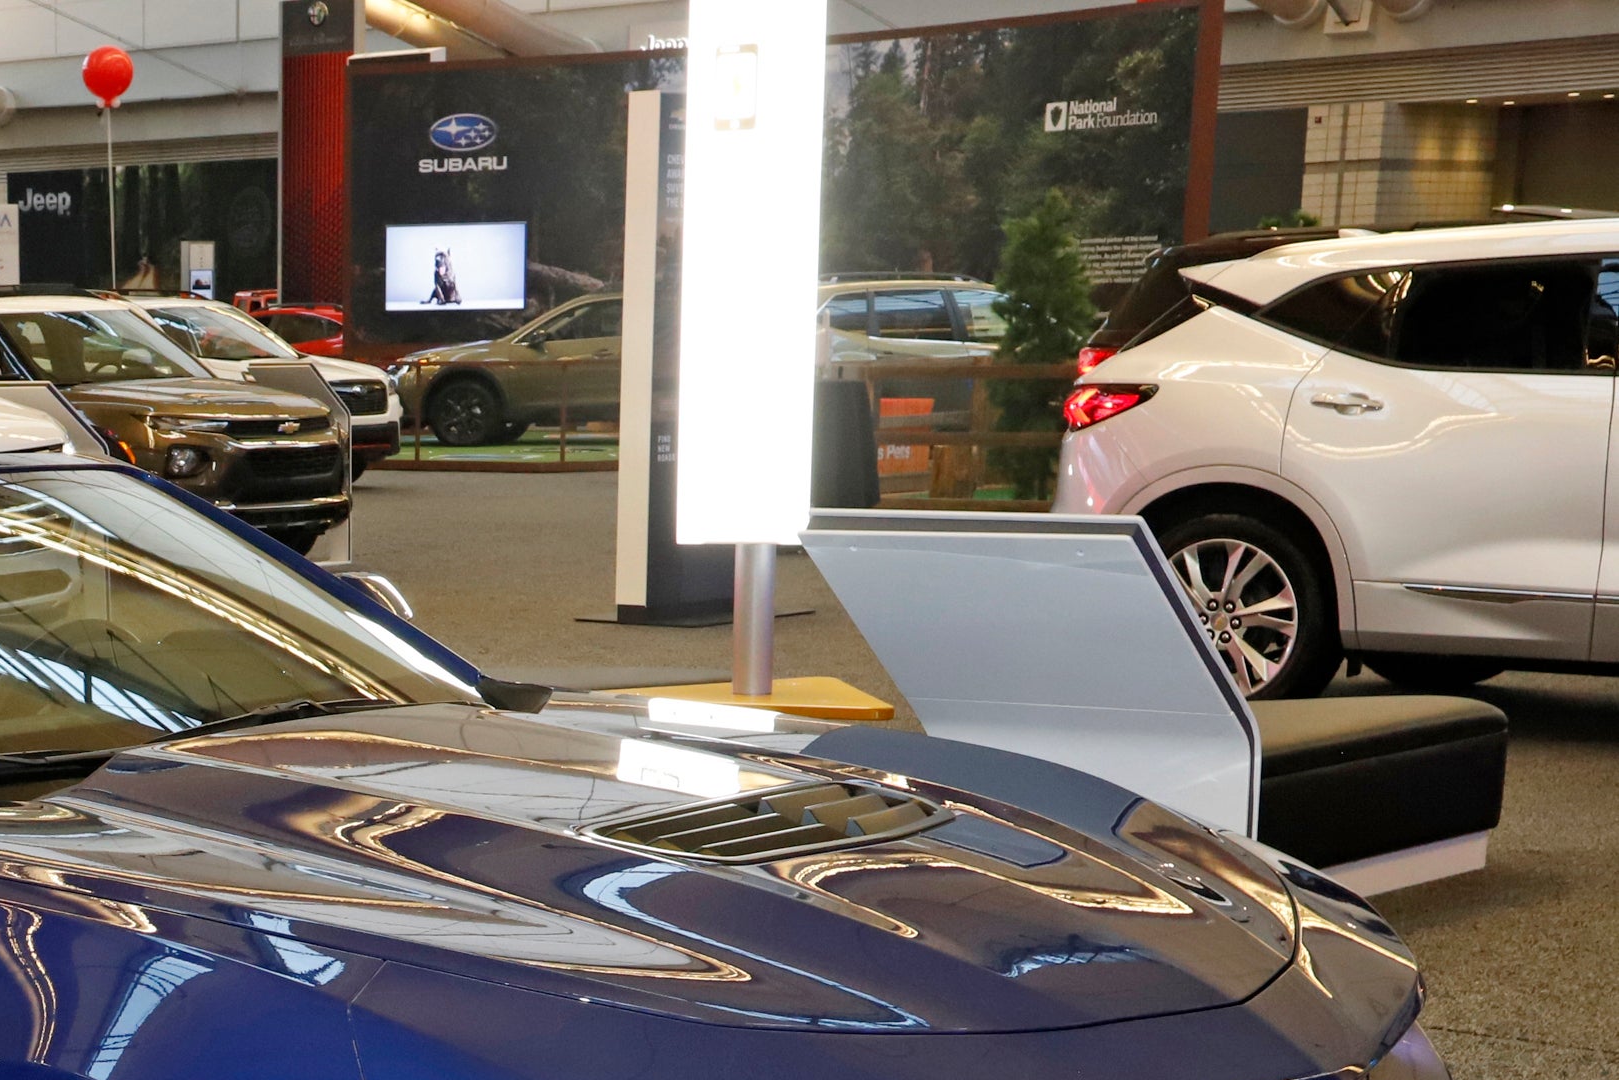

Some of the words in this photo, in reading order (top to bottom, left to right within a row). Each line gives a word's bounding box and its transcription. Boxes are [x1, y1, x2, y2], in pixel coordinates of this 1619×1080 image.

[1069, 97, 1117, 115] National
[1068, 114, 1095, 130] Park
[1096, 110, 1158, 128] Foundation
[418, 156, 508, 173] SUBARU
[18, 187, 72, 216] Jeep
